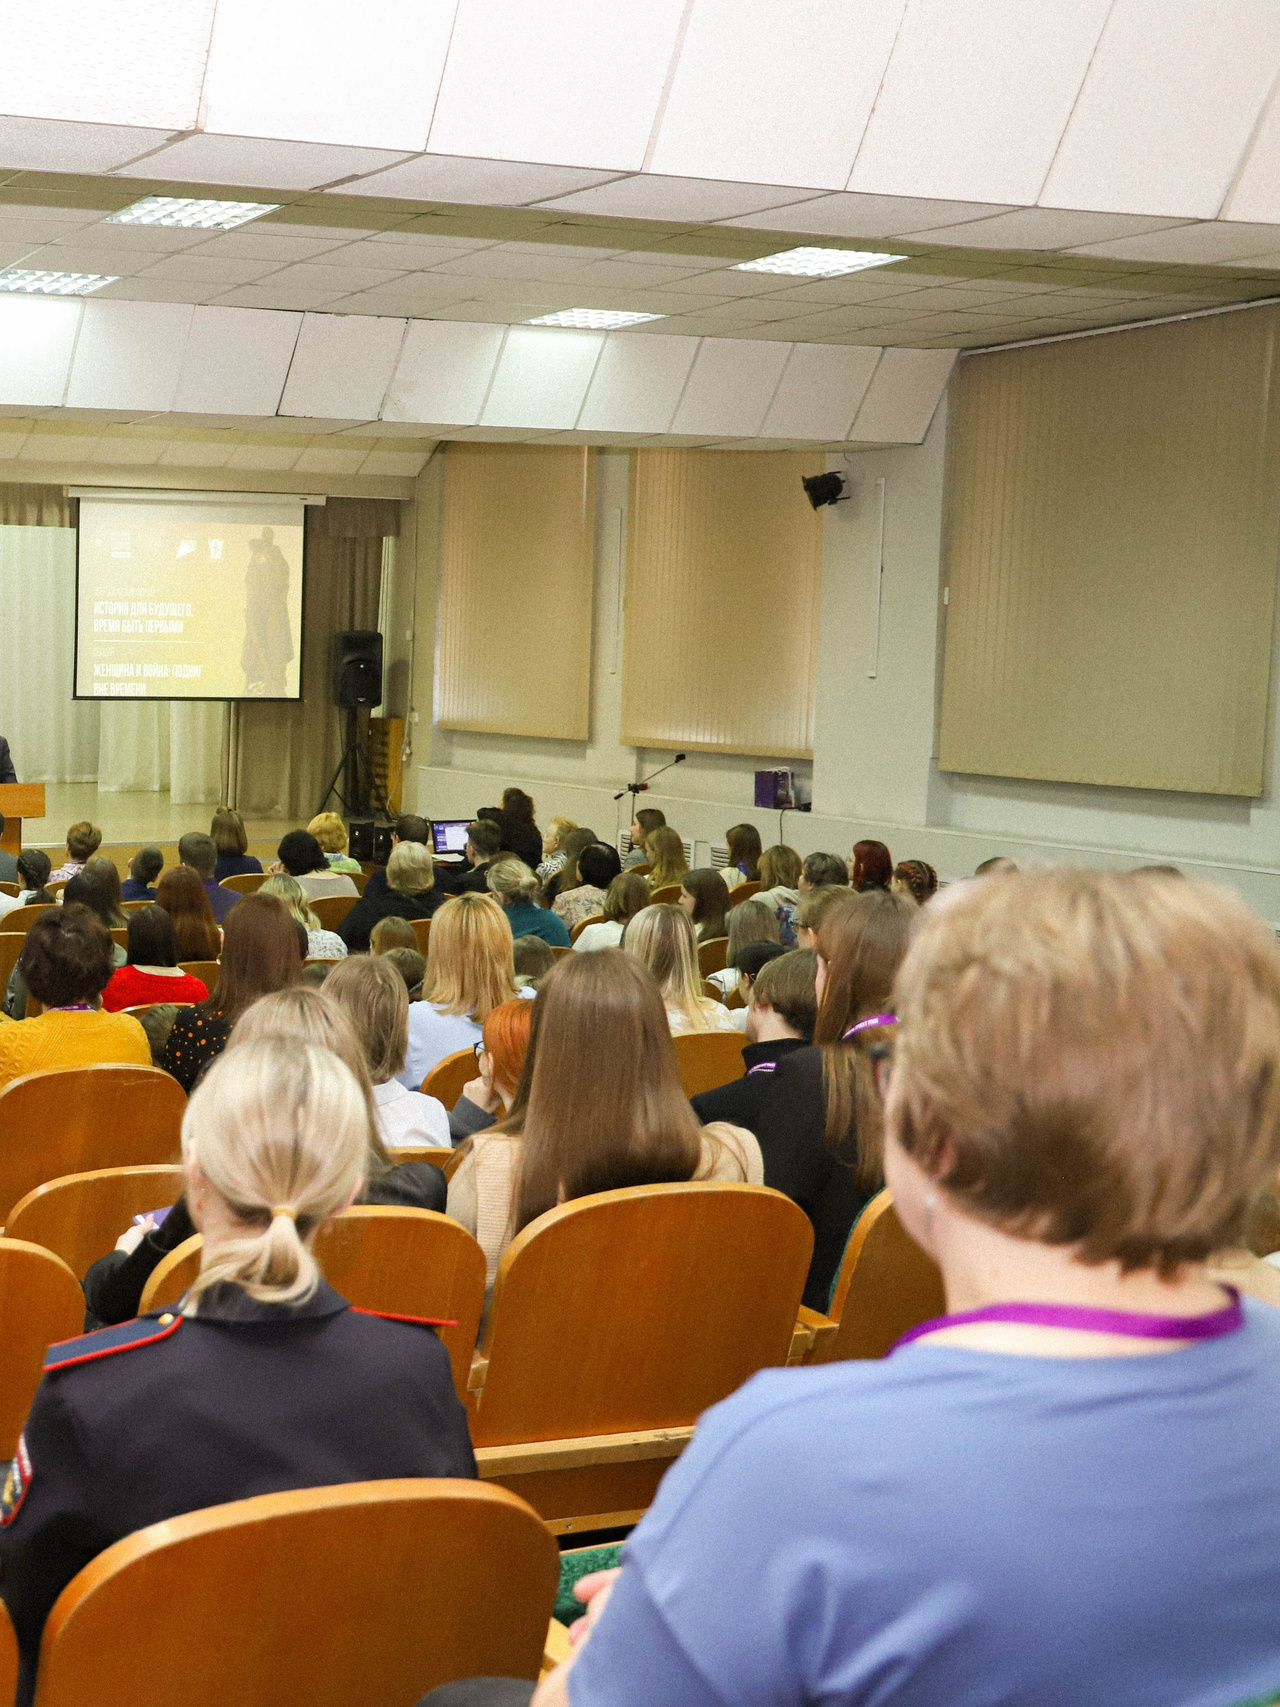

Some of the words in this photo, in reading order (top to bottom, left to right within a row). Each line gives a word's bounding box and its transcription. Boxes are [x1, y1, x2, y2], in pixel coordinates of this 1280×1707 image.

[93, 601, 129, 615] ИСТОРИЯ
[130, 602, 148, 617] ДЛЯ
[148, 602, 194, 618] БУДУЩЕГО.
[93, 619, 121, 632] ВРЕМЯ
[121, 619, 144, 633] БЫТЬ
[145, 620, 184, 634] ПЕРВЫМИ
[93, 664, 135, 678] ЖЕНЩИНА
[136, 664, 142, 677] И
[172, 664, 203, 678] ПОДВИГ
[93, 683, 109, 696] ВНЕ
[110, 683, 147, 696] ВРЕМЕНИ
